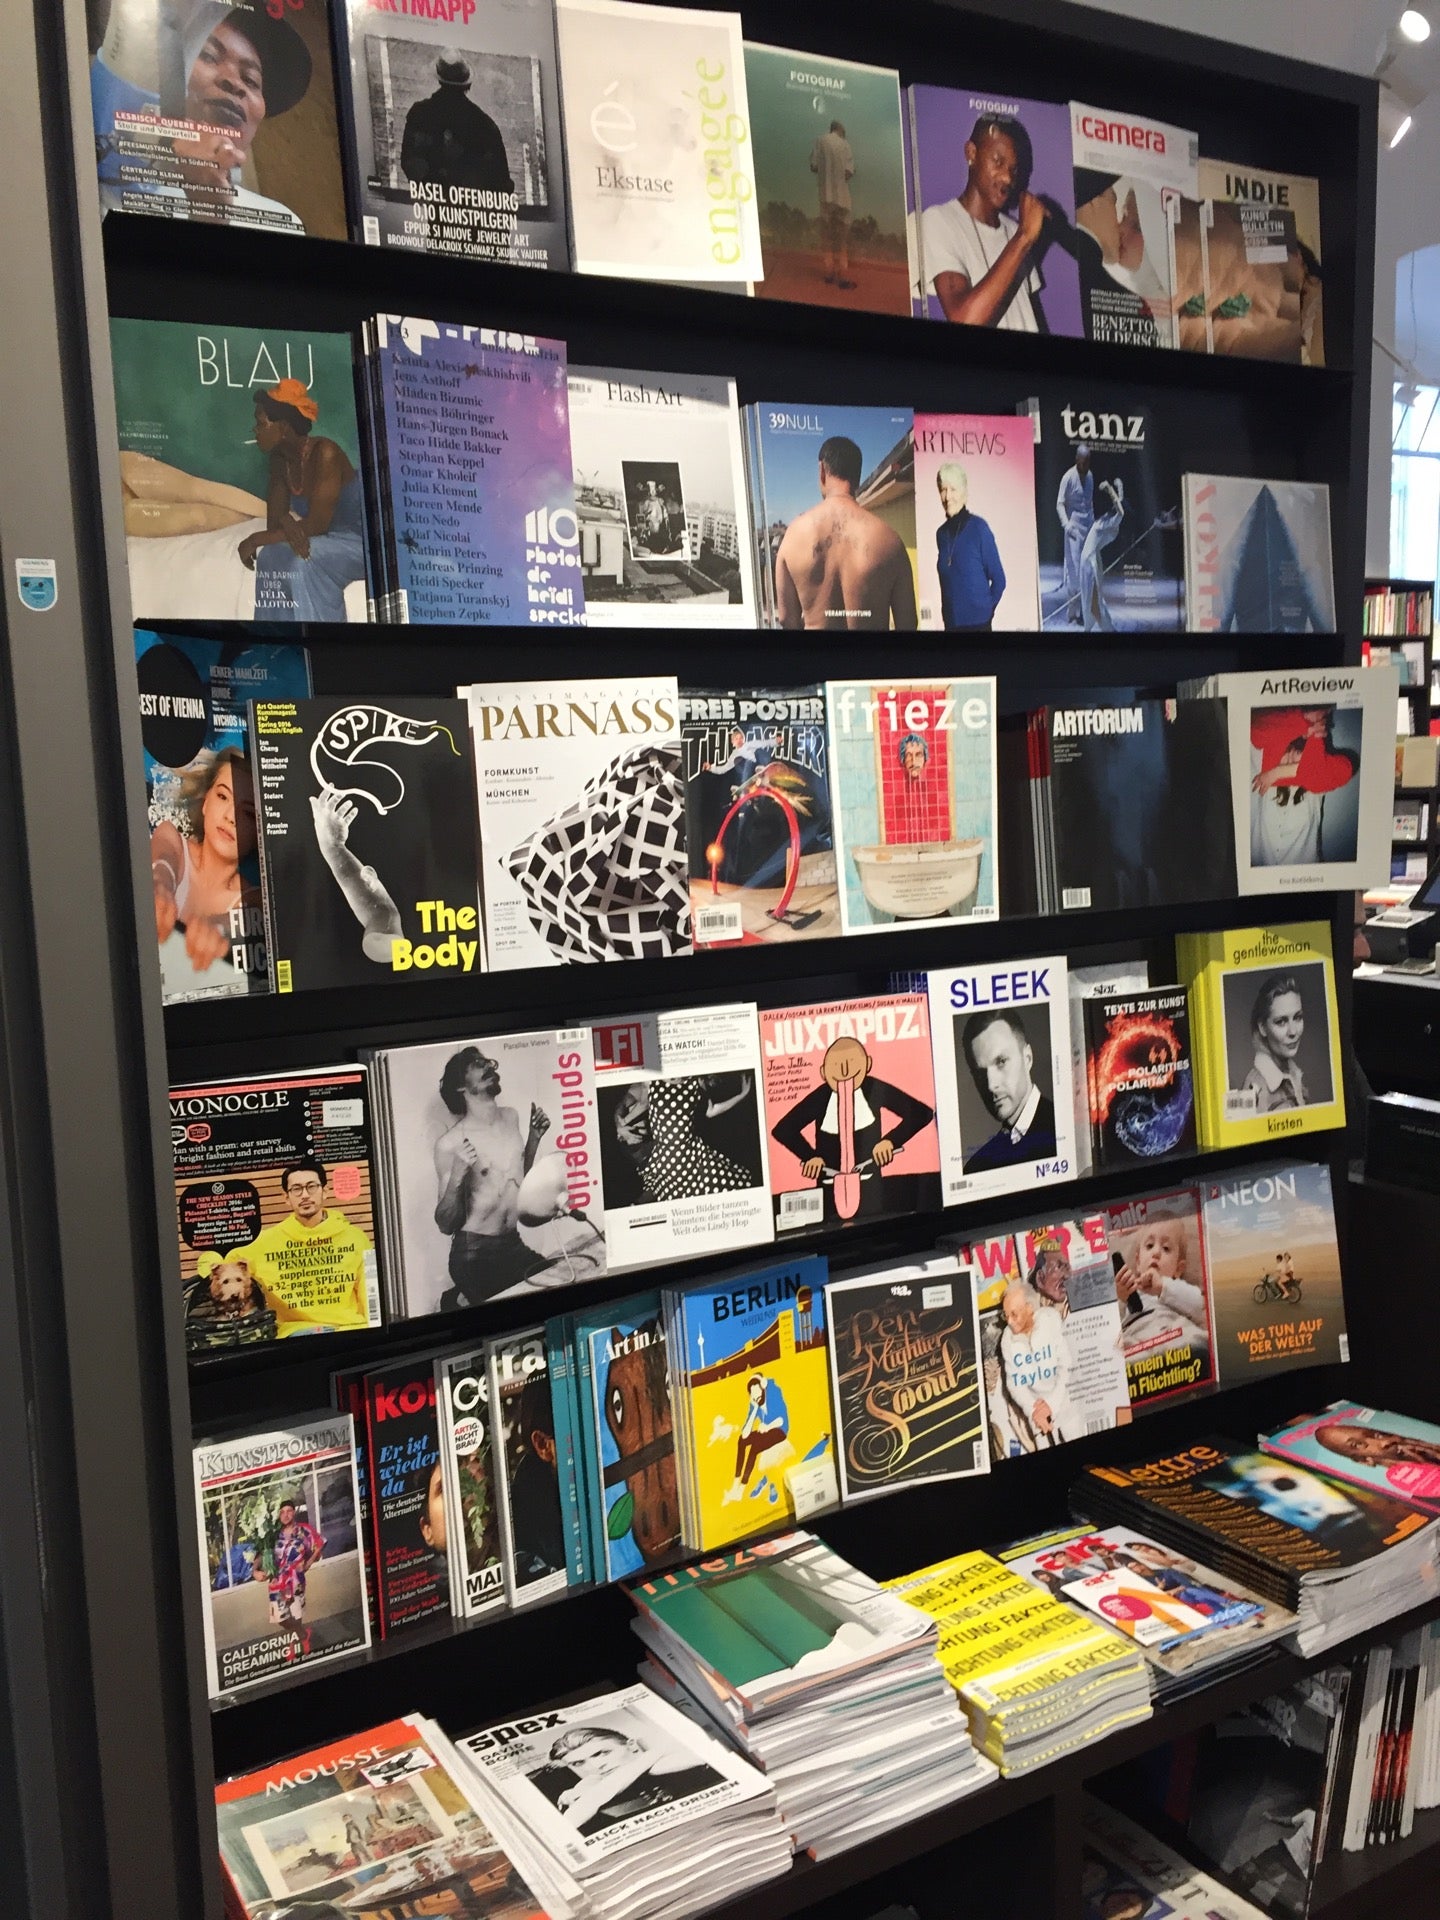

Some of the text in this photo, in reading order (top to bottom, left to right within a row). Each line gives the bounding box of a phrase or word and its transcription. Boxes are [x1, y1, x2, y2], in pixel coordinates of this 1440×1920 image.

[790, 71, 846, 90] FOTOGRAF
[968, 99, 1020, 115] FOTOGRAF
[197, 122, 241, 139] POLITIKEN
[1082, 116, 1166, 154] camera
[121, 165, 185, 180] GERTRAUD KLEMM
[682, 57, 752, 264] engagée
[596, 166, 674, 193] Ekstase
[1226, 173, 1290, 207] INDIE
[409, 180, 519, 212] BASEL OFFENBURG
[438, 206, 518, 231] KUNSTPILGERN
[404, 220, 529, 248] EPPUR SI MUOVE JEWELRY ART
[387, 234, 548, 260] BRODWOLF DELACROIX SCHWARZ SKUBIC VAUTIER
[198, 336, 314, 391] BLAU
[392, 367, 461, 389] Jens Asthoff
[393, 384, 438, 401] Mladen
[607, 382, 684, 406] Flash Art
[395, 400, 495, 424] Hannes Böhringer
[768, 412, 824, 432] 39NULL
[1061, 402, 1146, 442] tanz
[398, 432, 503, 456] Taco Hidde Bakker
[469, 425, 510, 442] Bonack
[399, 448, 445, 468] Stephan
[400, 464, 477, 483] Omar Kholeif
[402, 480, 478, 498] Julia Klement
[402, 496, 483, 515] Doreen Mende
[405, 512, 461, 529] Kito Nedo
[525, 506, 580, 548] 110
[406, 528, 471, 545] Olaf Nicolai
[453, 547, 488, 561] Peters
[526, 546, 582, 568] photos
[409, 559, 504, 579] Andreas Prinzing
[409, 574, 485, 593] Heidi Specker
[410, 590, 454, 606] Tatjana
[411, 605, 492, 623] Stephen Zepke
[824, 609, 873, 618] VERANTWORTUNG
[1260, 676, 1355, 697] ArtReview
[159, 695, 206, 720] OF VIENNA
[480, 697, 676, 741] PARNASS
[680, 697, 825, 722] FREE POSTER
[836, 688, 988, 734] frieze
[330, 710, 420, 749] SPIKE
[1052, 707, 1144, 738] ARTFORUM
[261, 757, 289, 765] Bernhard
[485, 766, 540, 778] FORMKUNST
[486, 788, 531, 799] MÜNCHEN
[416, 900, 477, 933] The
[391, 935, 479, 973] Body
[1233, 941, 1311, 966] gentlewoman
[949, 968, 1051, 1009] SLEEK
[1103, 995, 1186, 1017] TEXTE ZUR KUNST
[764, 1004, 921, 1057] JUXTAPOZ
[593, 1025, 642, 1066] LFI
[657, 1038, 706, 1053] SEA WATCH!
[767, 1058, 787, 1072] Jean
[1128, 1059, 1190, 1078] POLARITIES
[1108, 1075, 1168, 1093] POLARITÄT
[169, 1090, 291, 1117] MONOCLE
[552, 1051, 599, 1210] springerin
[1267, 1117, 1304, 1133] kirsten
[179, 1142, 297, 1166] bright fashion retail shifts
[189, 1138, 282, 1155] with survey
[1219, 1173, 1297, 1209] NEON
[265, 1242, 355, 1262] TIMEKEEPING and
[286, 1236, 334, 1249] Our debut
[974, 1217, 1110, 1279] WIRE
[278, 1254, 345, 1270] PENMANSHIP
[279, 1266, 345, 1281] supplement...
[274, 1273, 358, 1292] 32-page SPECIAL
[295, 1289, 316, 1301] why
[318, 1295, 342, 1307] wrist
[712, 1273, 803, 1323] BERLIN
[1237, 1318, 1325, 1346] WAS TUN AUF
[601, 1333, 632, 1365] Art
[1013, 1344, 1053, 1368] Cecil
[1250, 1333, 1314, 1356] DER WELT?
[1134, 1344, 1192, 1376] mein Kind
[504, 1372, 547, 1392] FILMMAGAZIN
[1012, 1364, 1059, 1389] Taylor
[1139, 1357, 1202, 1395] Flüchtling?
[378, 1433, 429, 1465] Er ist
[454, 1430, 480, 1446] NICHT
[199, 1425, 351, 1480] KUNSTFORUM
[378, 1447, 440, 1482] wieder
[1129, 1444, 1221, 1483] lettre
[381, 1478, 406, 1499] da
[396, 1491, 427, 1508] deutsche
[382, 1502, 424, 1521] Alternative
[938, 1559, 1000, 1592] FAKTEN
[1082, 1572, 1115, 1588] art
[222, 1631, 301, 1665] CALIFORNIA
[945, 1611, 1081, 1685] ACHTUNG FAKTEN
[223, 1646, 292, 1677] DREAMING
[1067, 1641, 1137, 1682] FAKTEN
[467, 1712, 568, 1756] spex
[479, 1742, 526, 1766] DAVID
[484, 1748, 536, 1772] BOWIE
[264, 1744, 393, 1798] MOUSSE
[583, 1779, 742, 1852] BLICK NACH DRÜBEN
